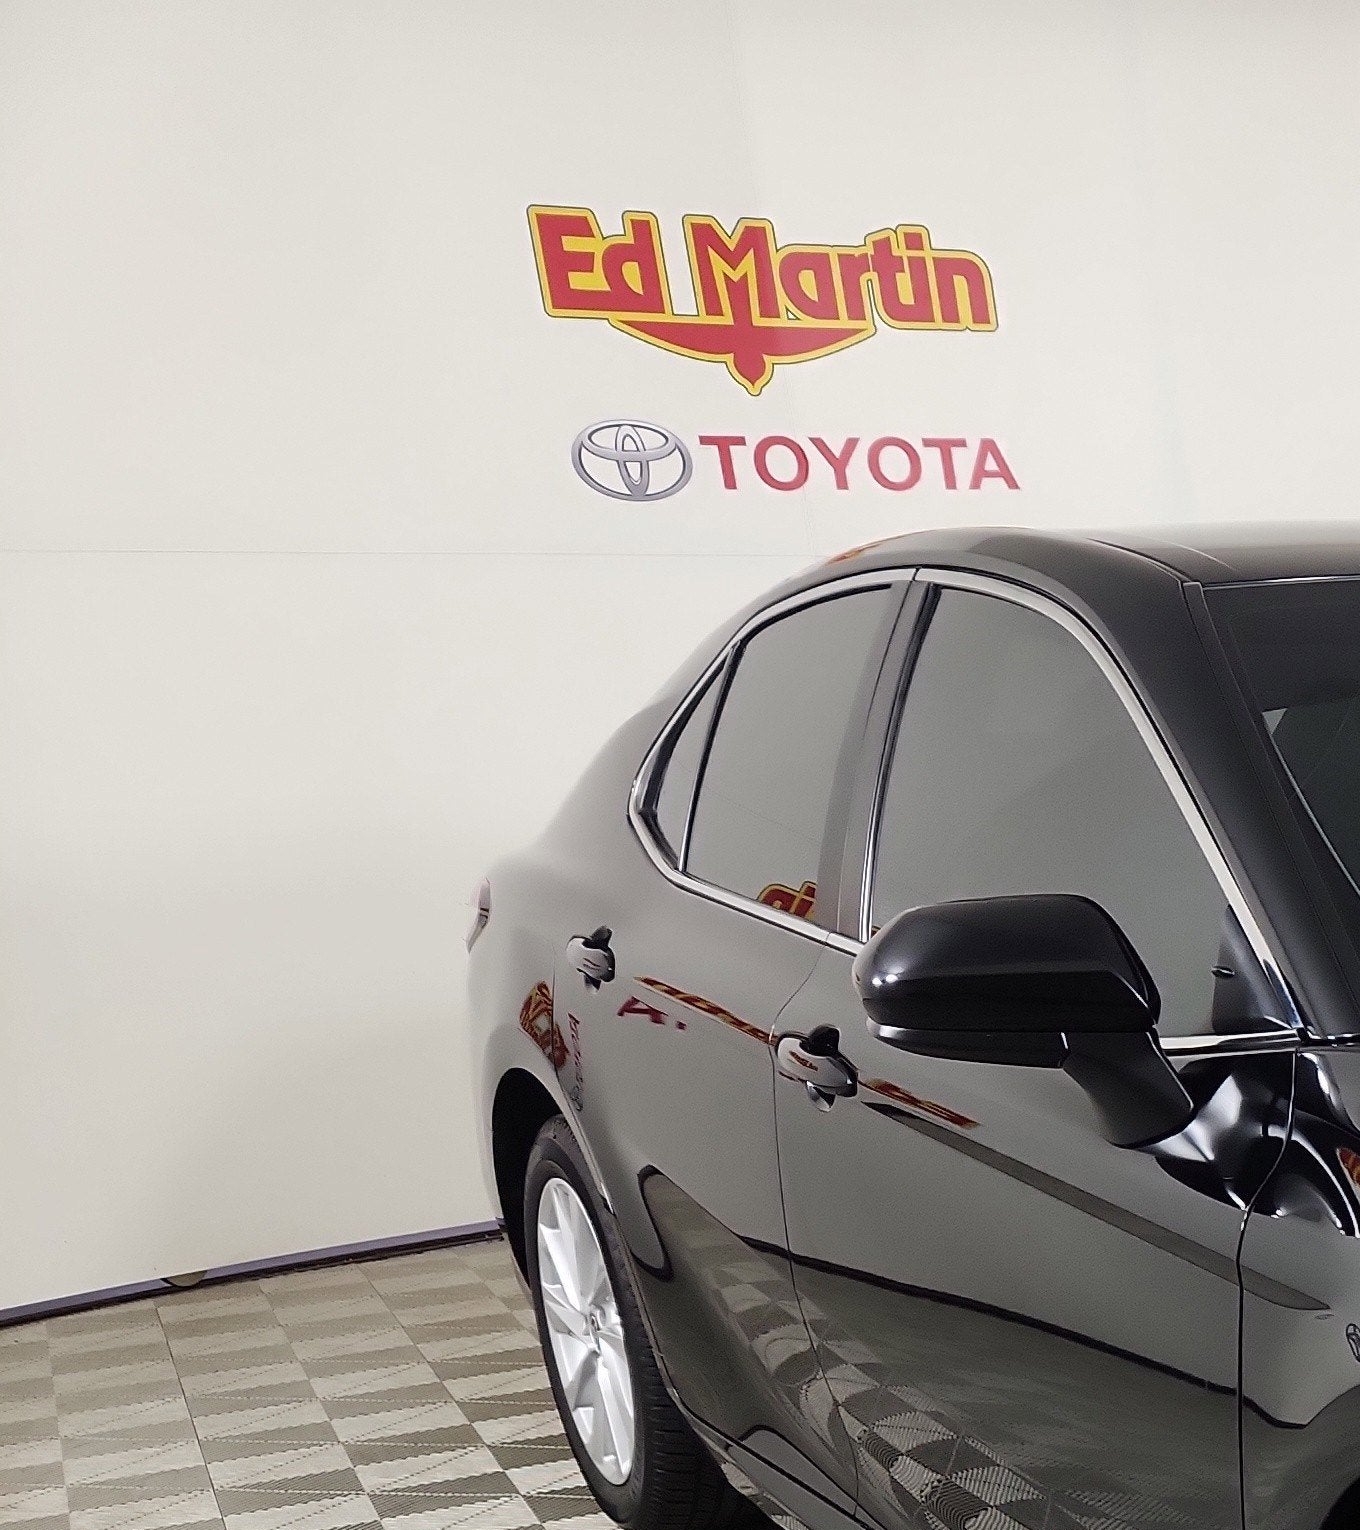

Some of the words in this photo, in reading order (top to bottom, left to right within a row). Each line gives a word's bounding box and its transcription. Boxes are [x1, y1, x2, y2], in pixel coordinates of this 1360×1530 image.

[529, 206, 670, 318] Ed
[684, 213, 998, 332] Martin
[698, 434, 1021, 491] TOYOTA
